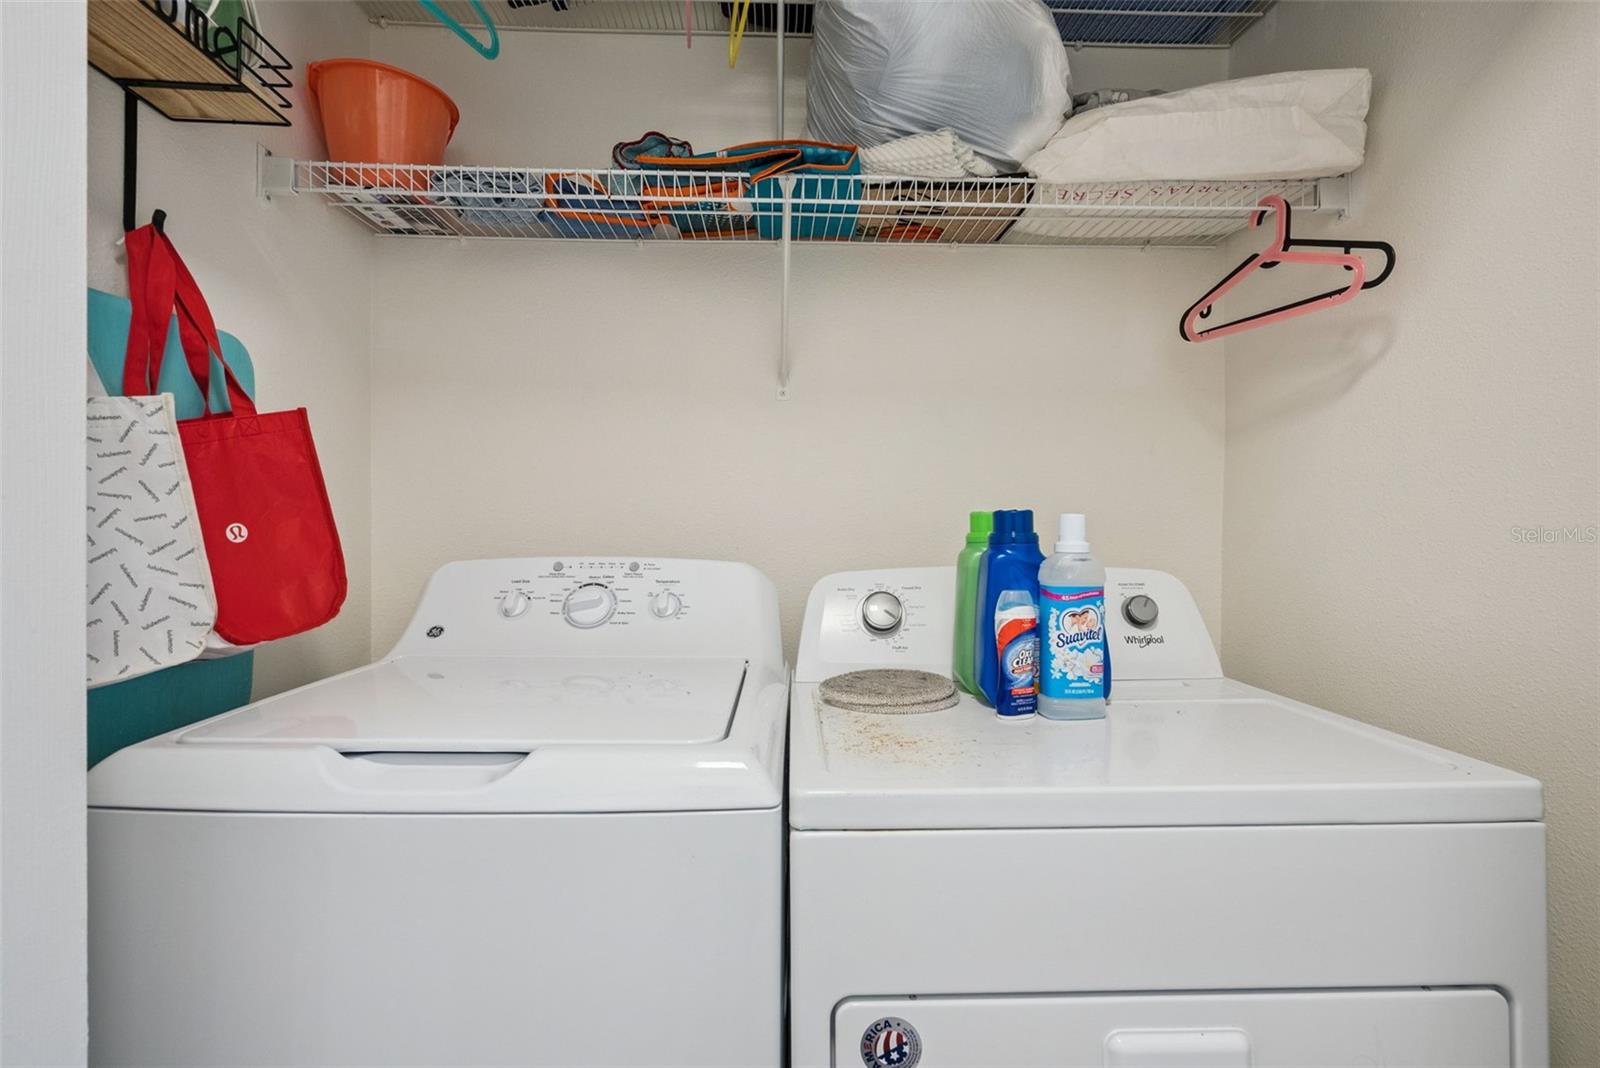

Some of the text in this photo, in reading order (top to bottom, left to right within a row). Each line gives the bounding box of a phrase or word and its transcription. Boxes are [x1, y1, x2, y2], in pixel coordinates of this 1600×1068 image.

[1055, 186, 1138, 201] SECRE
[97, 450, 131, 458] lululemon
[1056, 627, 1101, 648] Suavitel
[1124, 634, 1164, 648] Whirlpool
